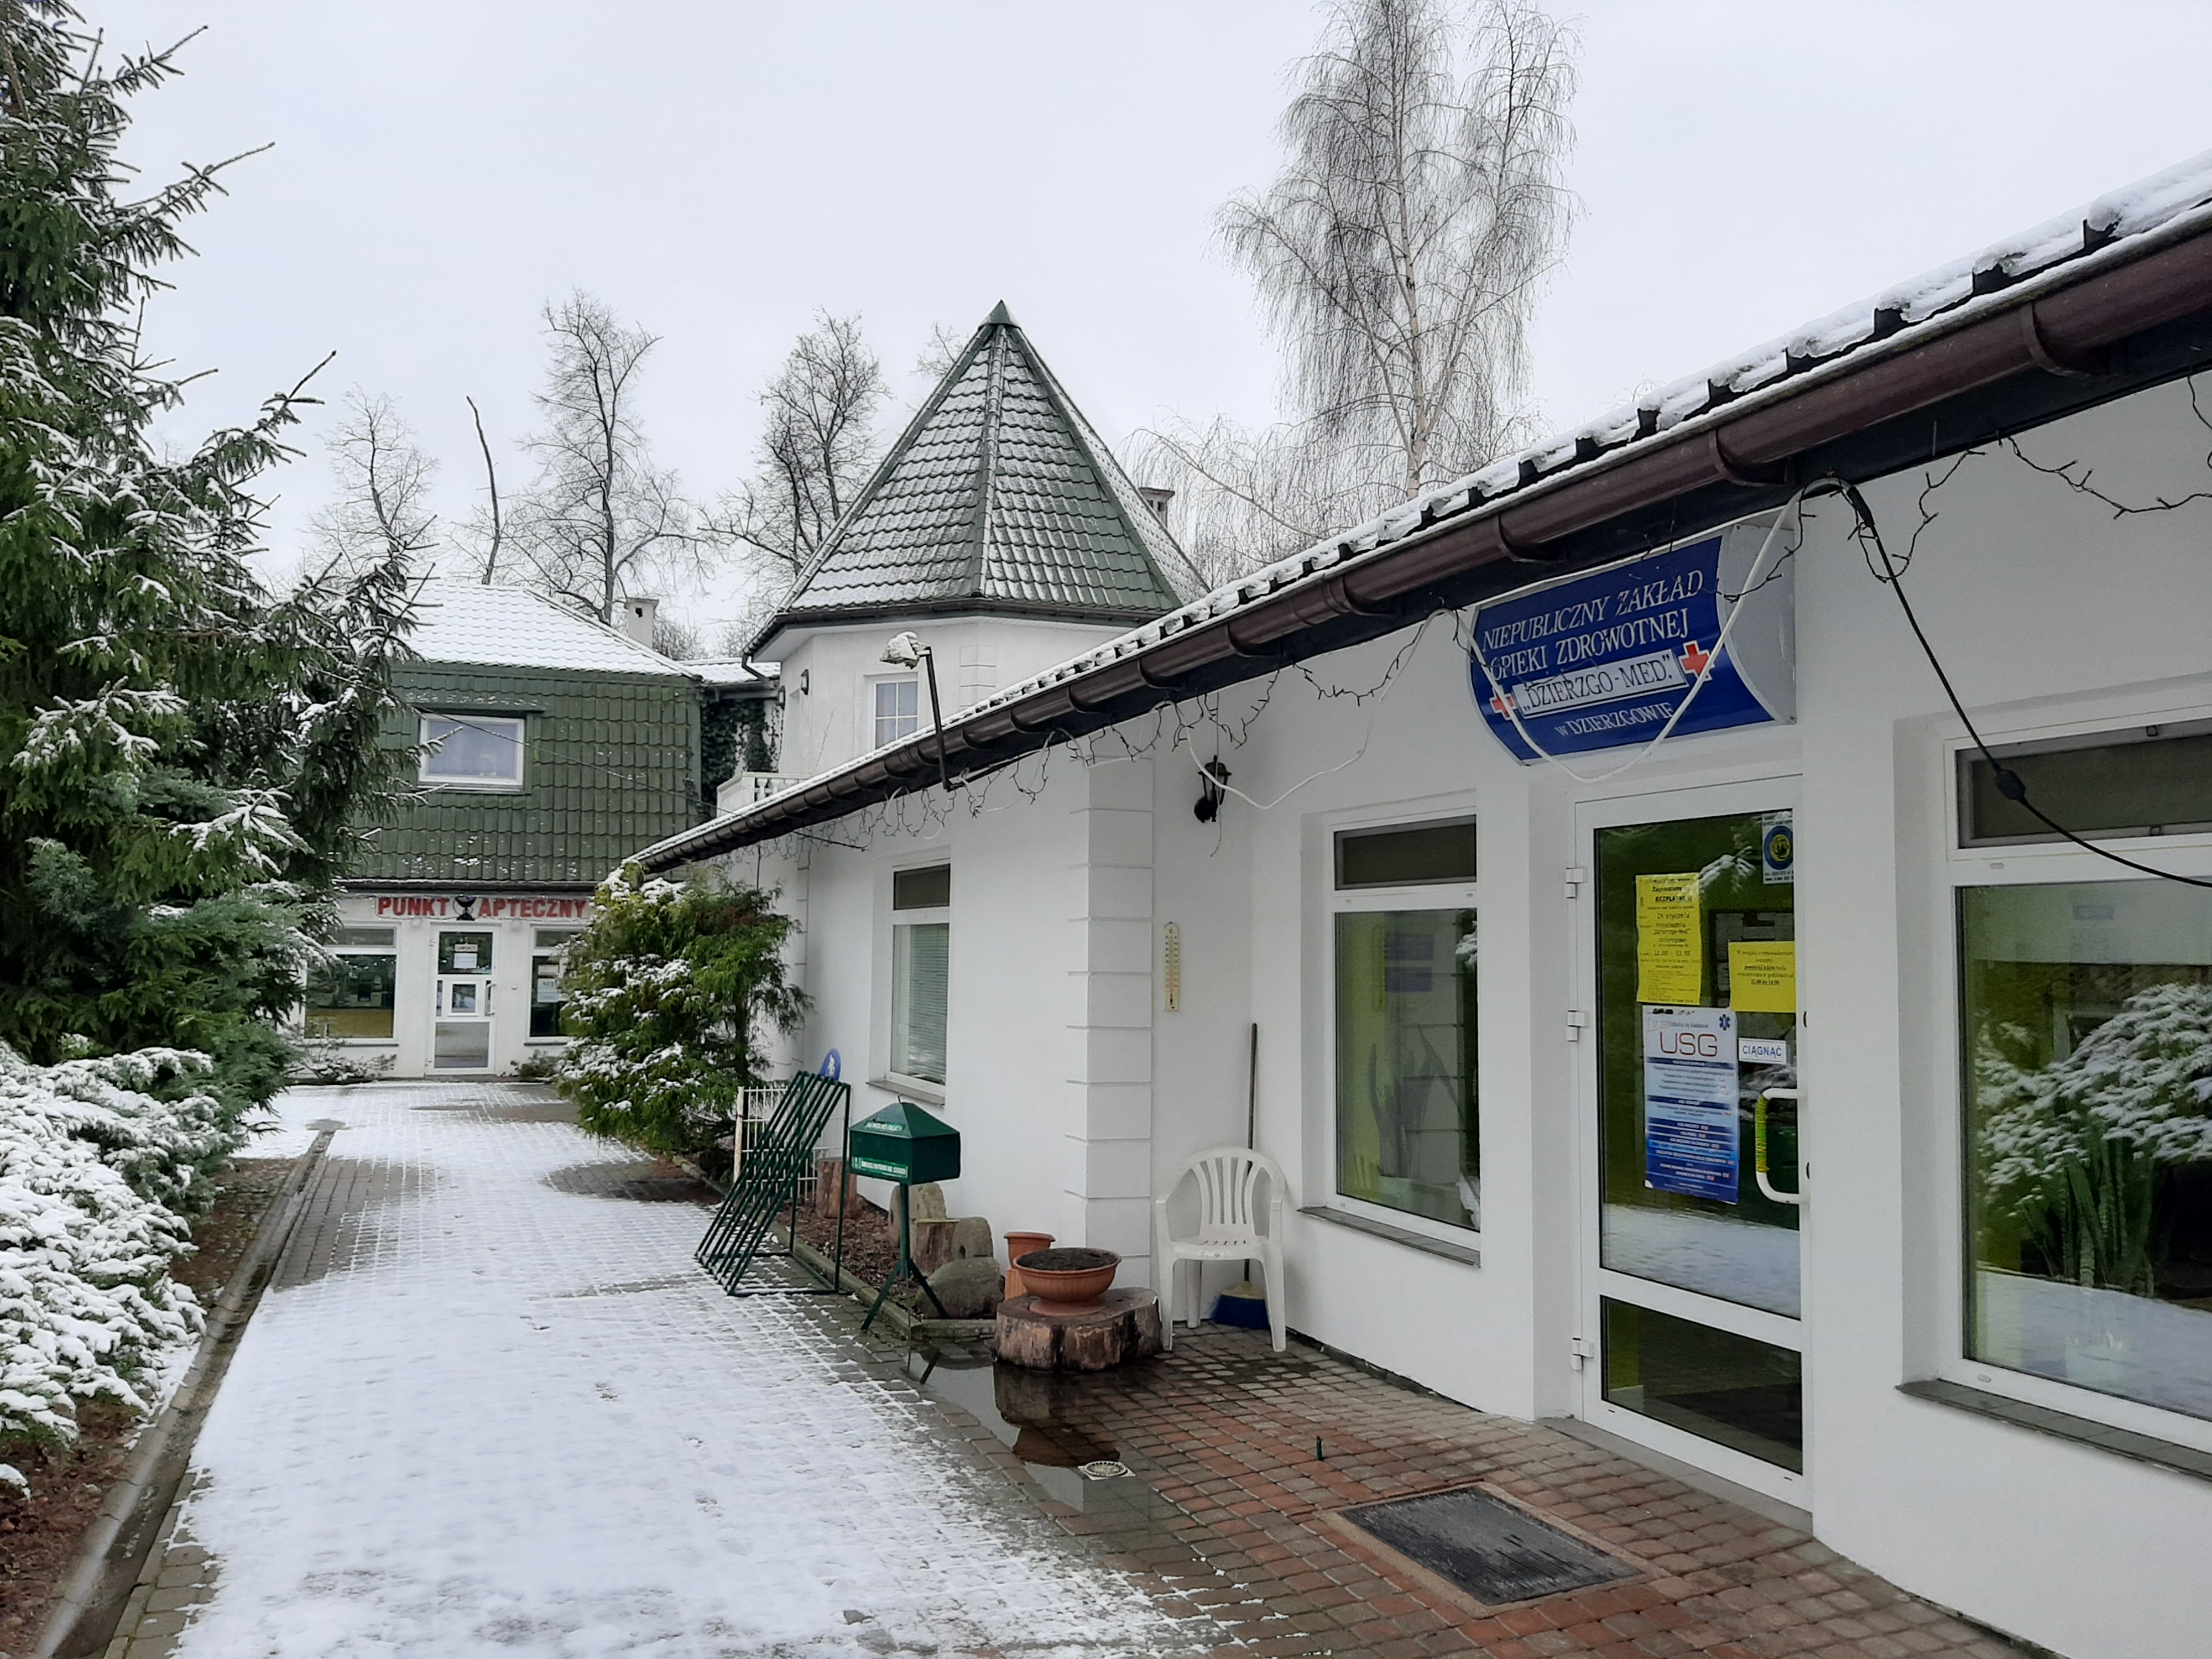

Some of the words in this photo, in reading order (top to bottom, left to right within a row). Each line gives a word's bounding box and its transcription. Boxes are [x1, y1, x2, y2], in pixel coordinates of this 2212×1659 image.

[1481, 596, 1610, 653] NIEPUBLICZNY
[1615, 570, 1703, 616] ZAKŁAD
[1490, 645, 1548, 681] OPIEKI
[1555, 607, 1688, 665] ZDROWOTNEJ
[1566, 702, 1674, 734] DZIERZGOWIE
[378, 896, 450, 916] PUNKT
[478, 897, 587, 918] APTECZNY
[1660, 1031, 1718, 1057] USG
[1743, 1045, 1782, 1058] CIĄGNĄĆ
